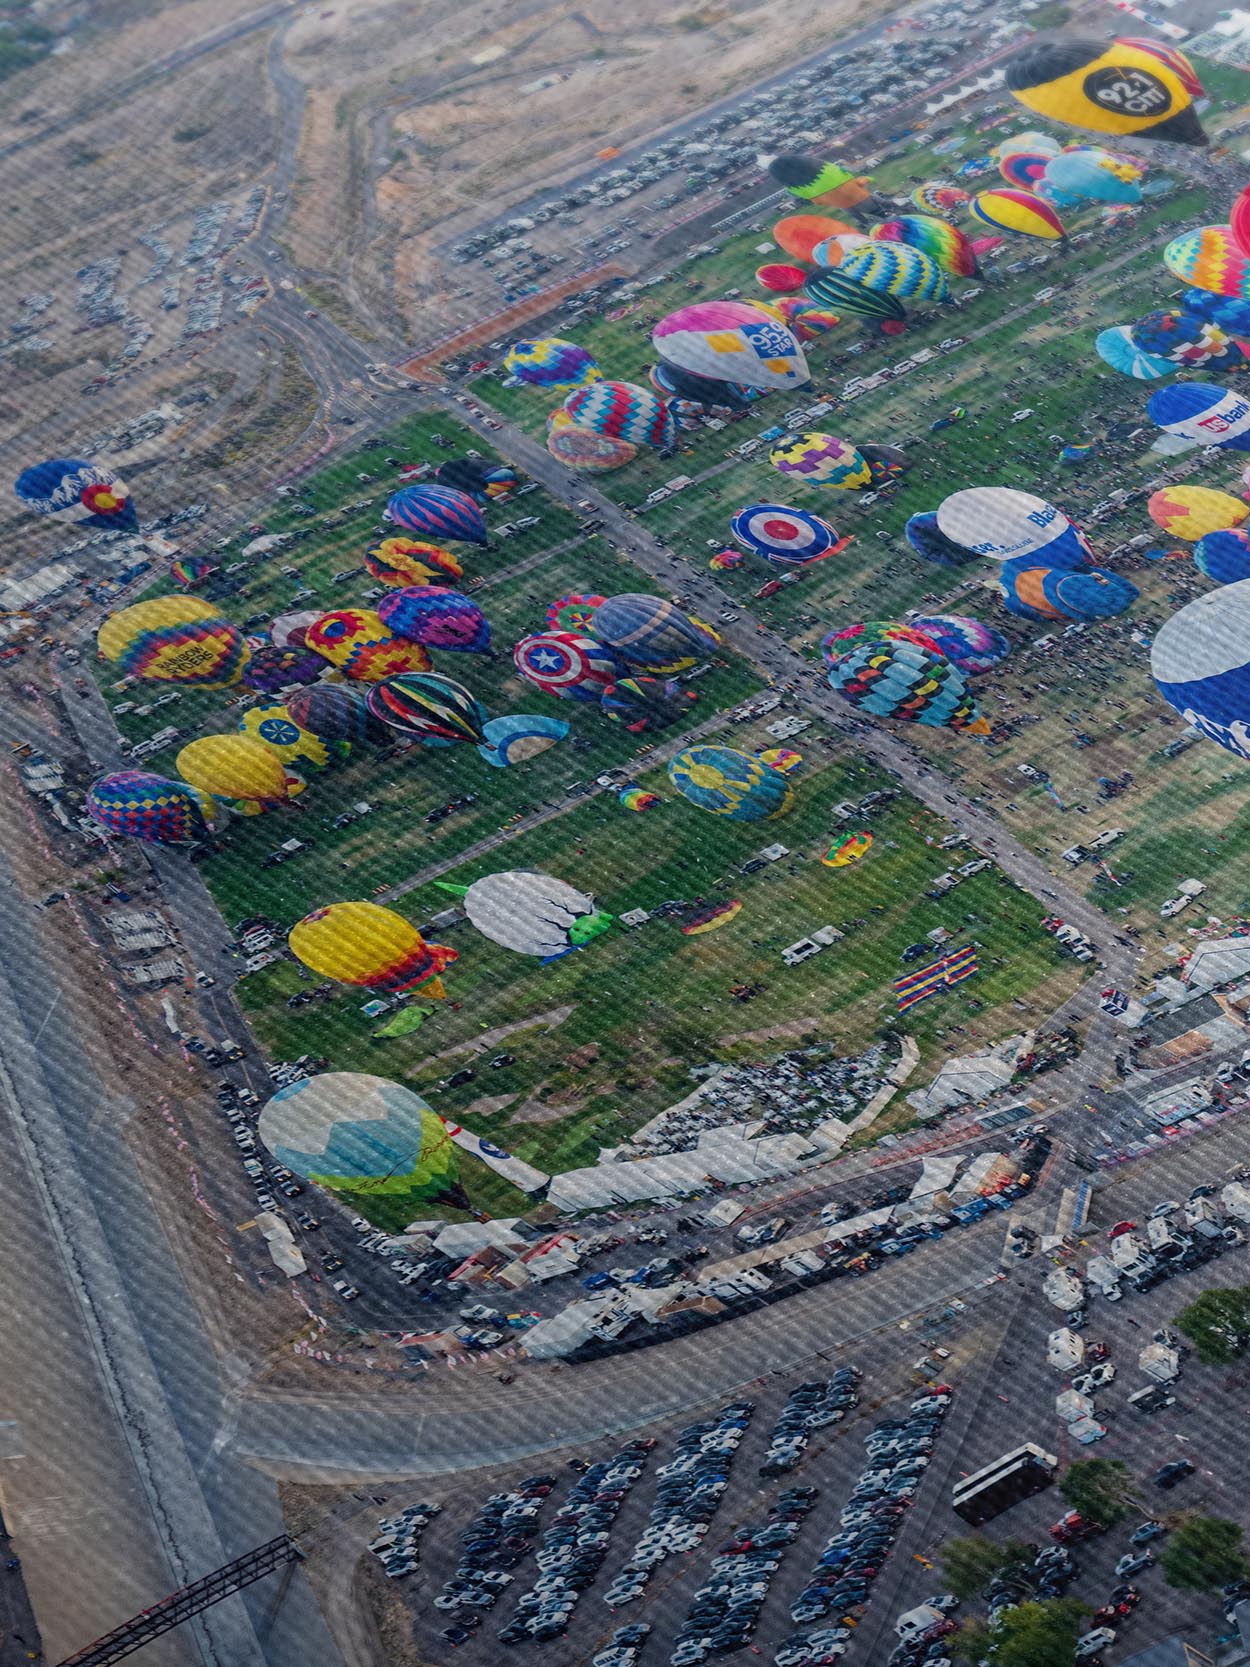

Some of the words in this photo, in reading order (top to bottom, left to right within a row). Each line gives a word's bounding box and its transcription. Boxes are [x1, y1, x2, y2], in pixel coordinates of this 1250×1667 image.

[767, 338, 793, 356] STAR
[156, 645, 204, 669] RAINBOW
[167, 650, 214, 675] RYDERS
